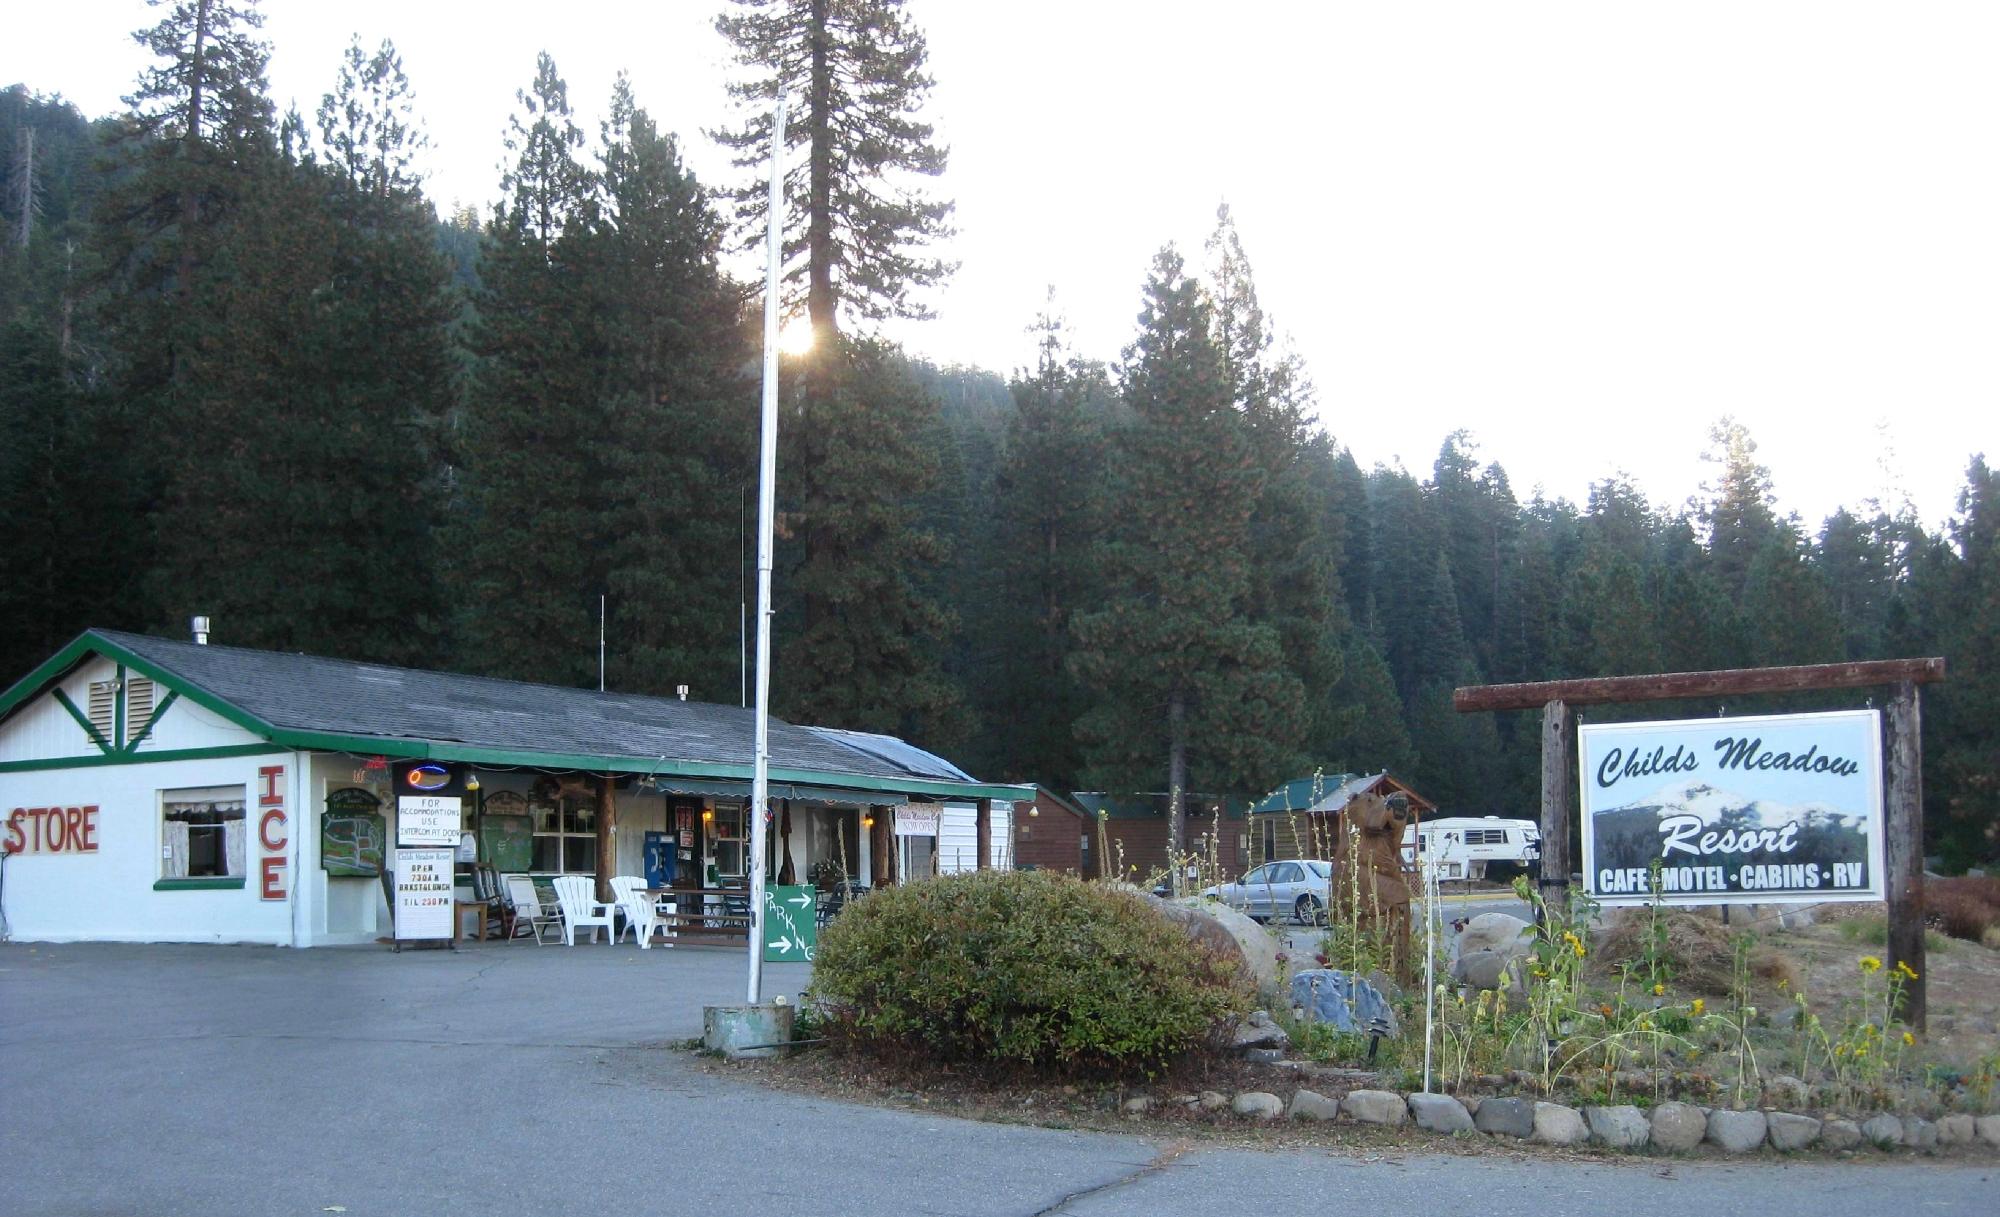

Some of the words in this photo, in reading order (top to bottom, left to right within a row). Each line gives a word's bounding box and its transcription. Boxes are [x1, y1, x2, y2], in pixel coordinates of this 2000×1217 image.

[1597, 745, 1699, 788] Childs
[1714, 737, 1858, 777] Meadow
[399, 808, 460, 817] ACCOMMODATIONS
[421, 799, 440, 808] FOR
[3, 805, 99, 854] STORE
[258, 765, 288, 899] ICE
[421, 818, 438, 826] USE
[400, 828, 431, 836] INTERCOM
[431, 828, 440, 837] AT
[442, 829, 461, 837] DOOR
[1658, 814, 1799, 858] Resort
[411, 864, 433, 873] OPEN
[1600, 868, 1649, 893] CAFE
[1661, 866, 1727, 891] MOTEL
[1740, 863, 1819, 889] CABINS
[1833, 862, 1863, 888] RV
[404, 898, 419, 906] TIL
[765, 892, 815, 960] PARKING
